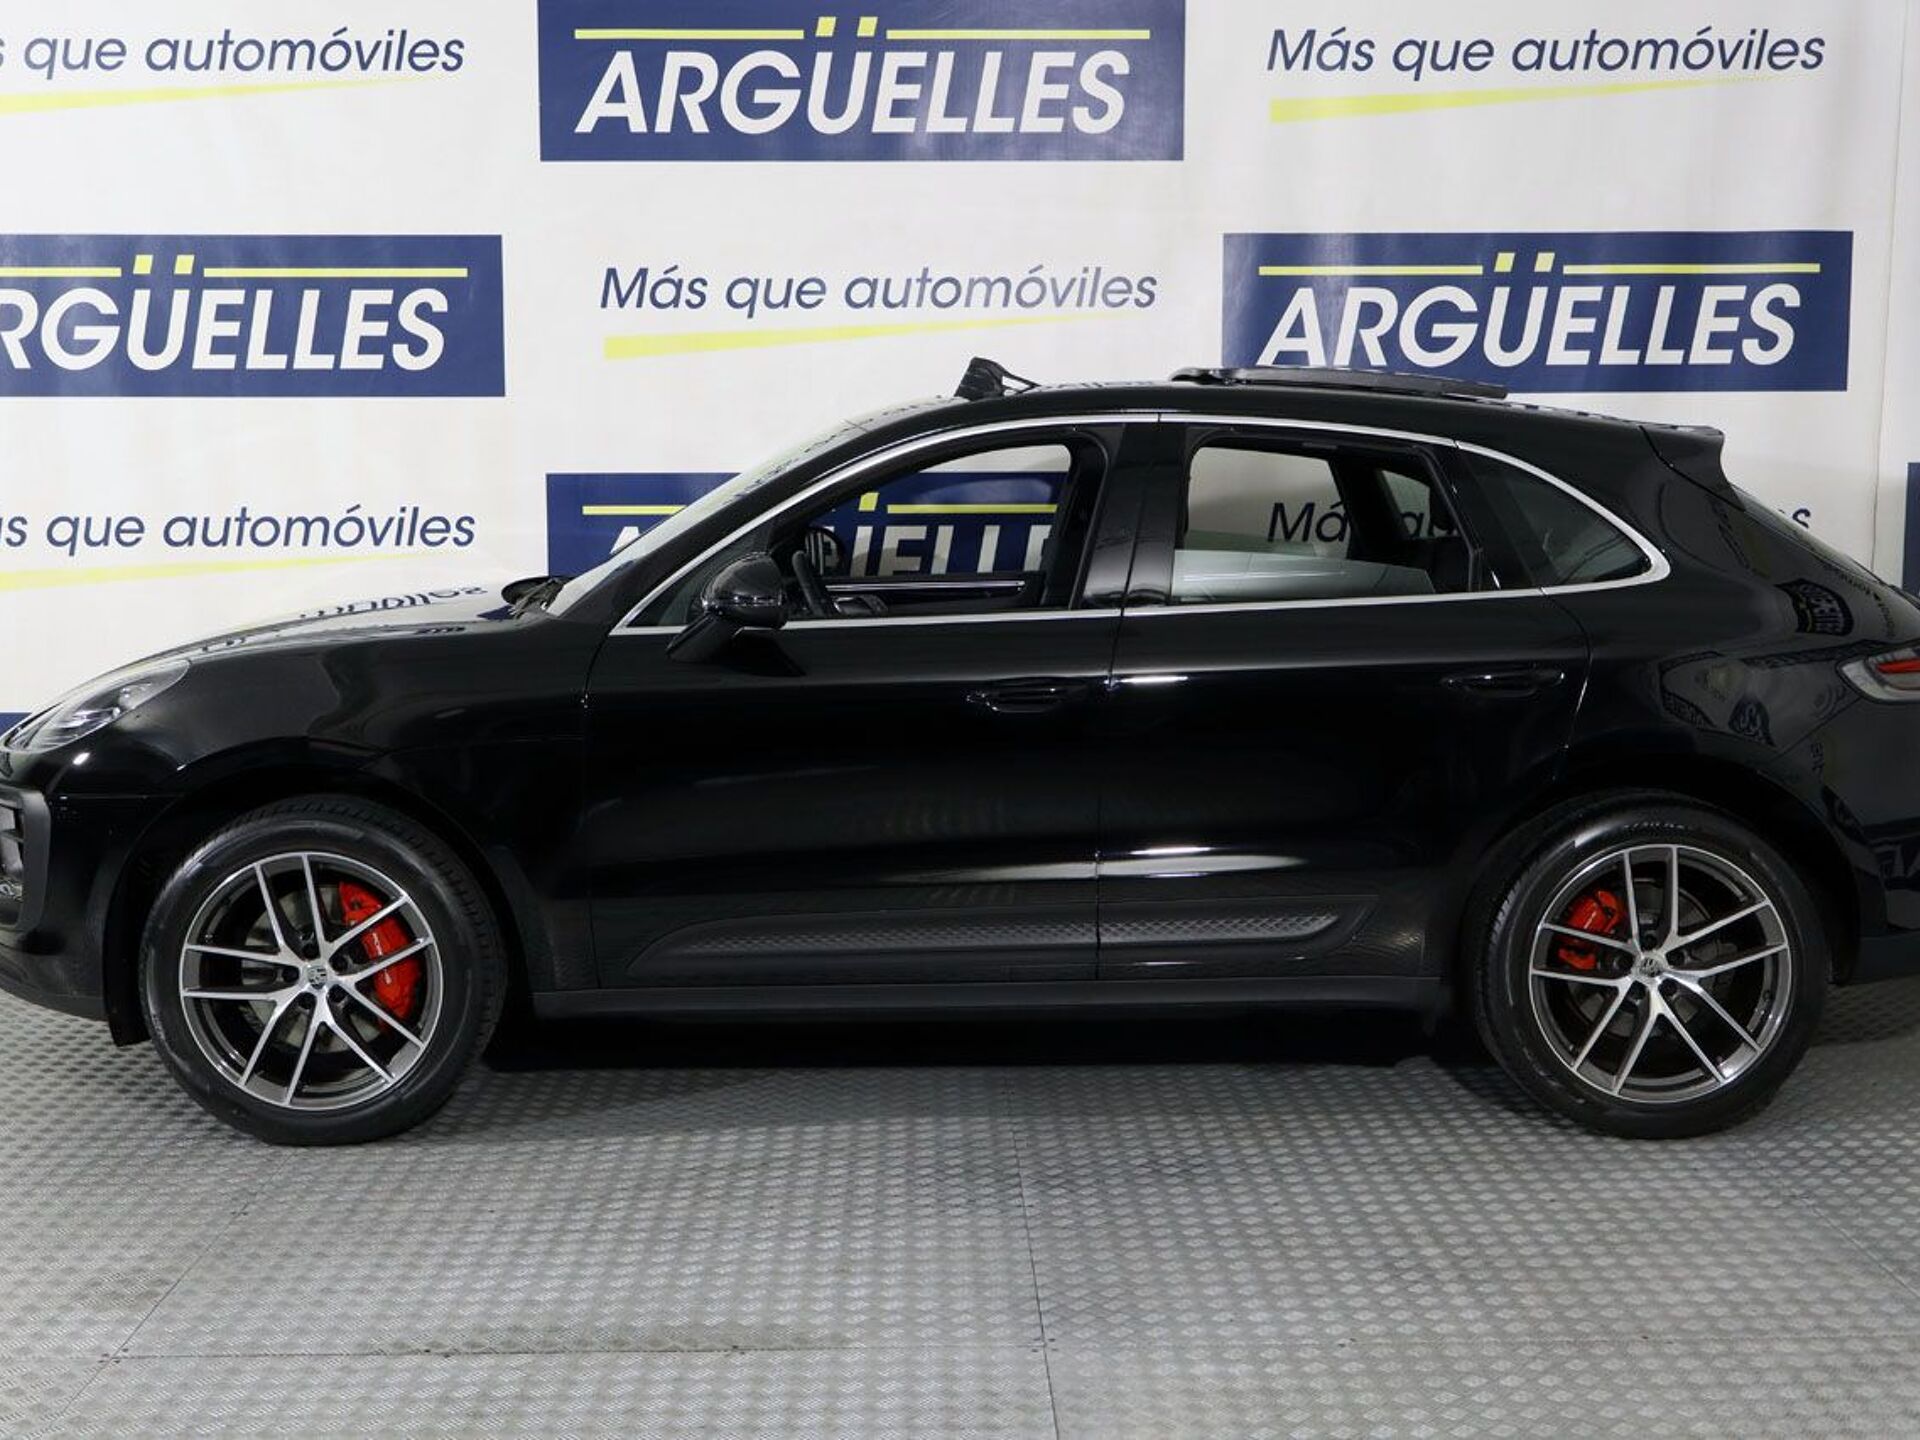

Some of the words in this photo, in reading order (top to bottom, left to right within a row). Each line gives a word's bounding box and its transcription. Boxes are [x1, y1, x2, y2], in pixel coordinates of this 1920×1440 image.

[24, 37, 127, 80] que
[145, 26, 465, 72] automóviles
[575, 16, 1130, 134] ARGÜELLES
[1266, 26, 1376, 72] Más
[1392, 38, 1495, 82] que
[1511, 25, 1826, 72] automóviles
[600, 264, 709, 310] Más
[725, 276, 827, 320] que
[844, 264, 1158, 310] automóviles
[1256, 252, 1800, 369] ARGÜELLES
[46, 515, 146, 557] que
[162, 503, 476, 548] automóviles
[1266, 500, 1350, 543] Má
